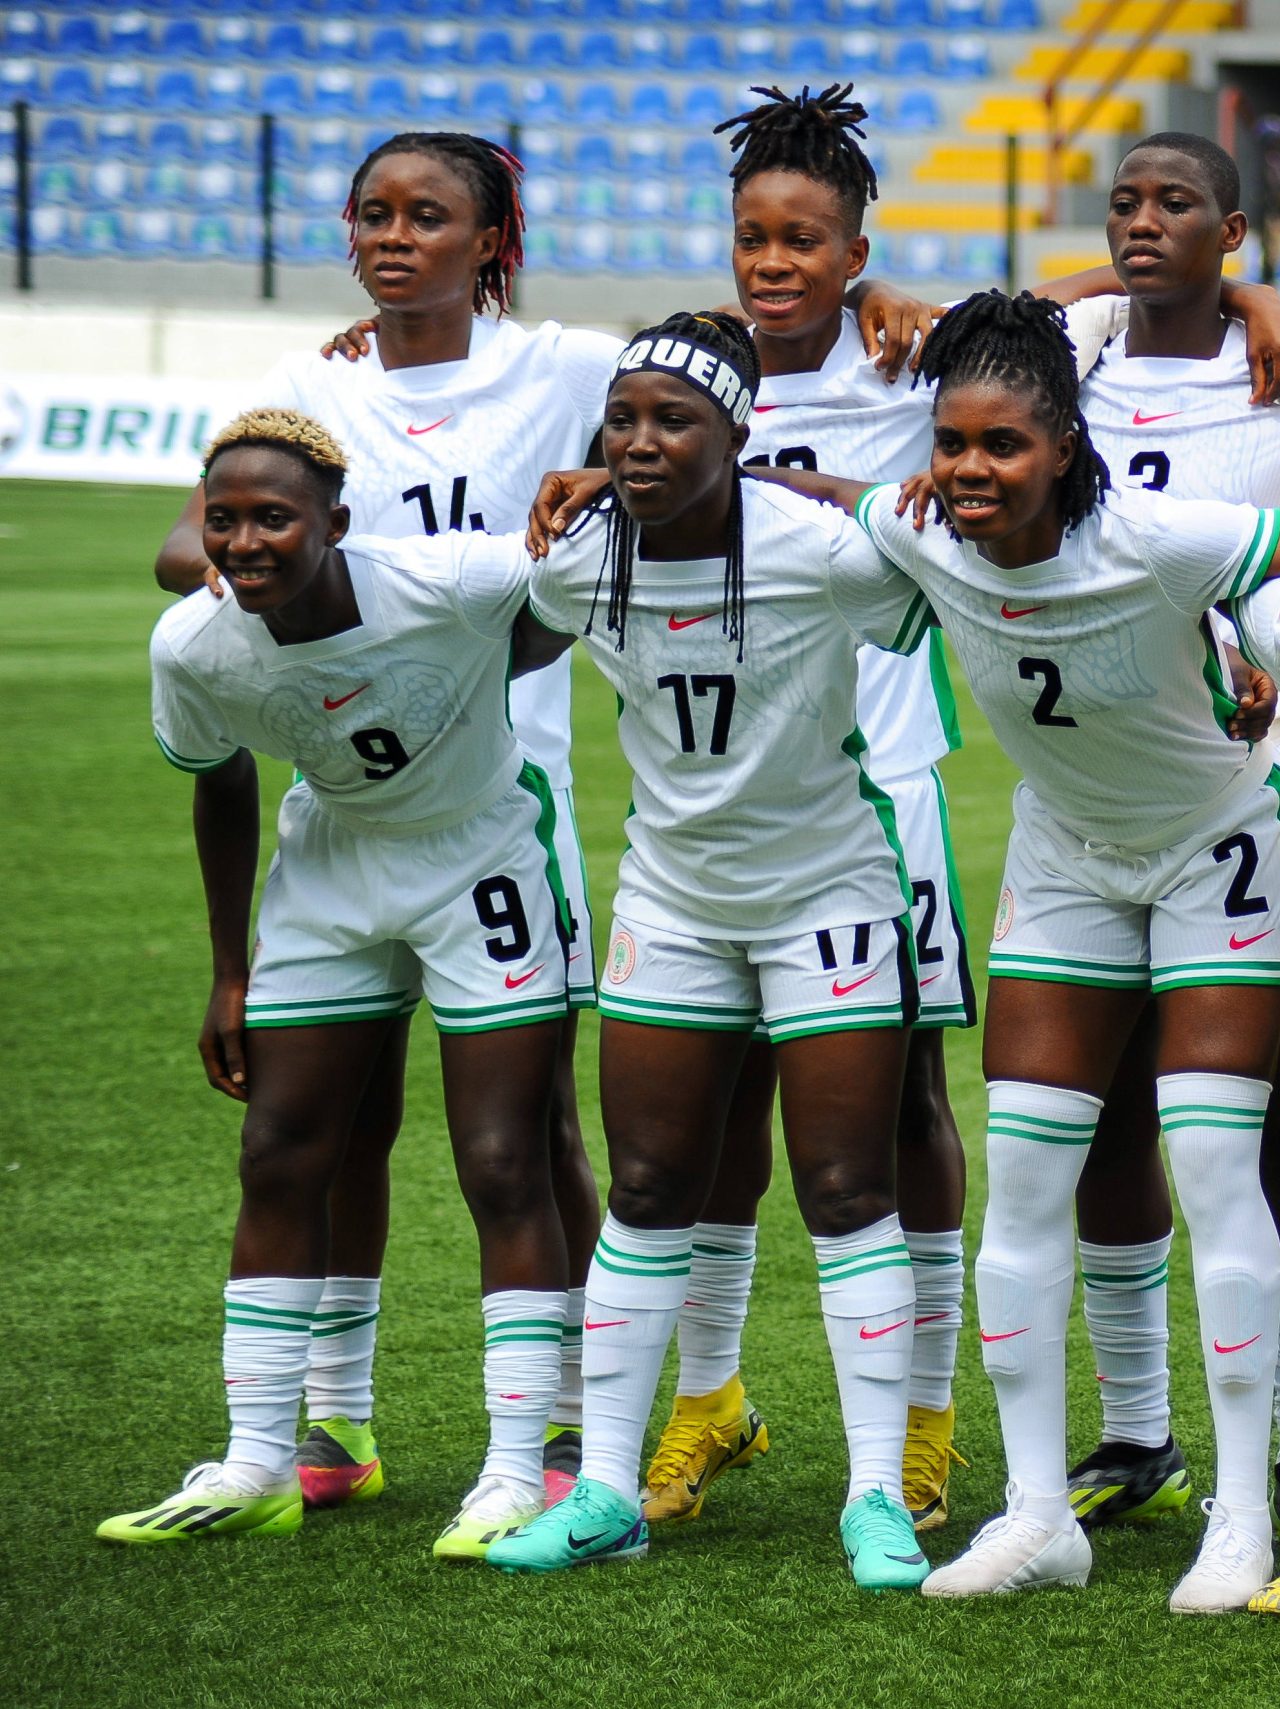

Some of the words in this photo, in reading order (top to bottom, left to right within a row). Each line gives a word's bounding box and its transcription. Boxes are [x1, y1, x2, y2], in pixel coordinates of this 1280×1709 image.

[656, 673, 737, 756] 17
[1017, 656, 1080, 729] 2
[349, 727, 410, 781] 9
[1209, 831, 1270, 918] 2
[472, 874, 531, 963] 9
